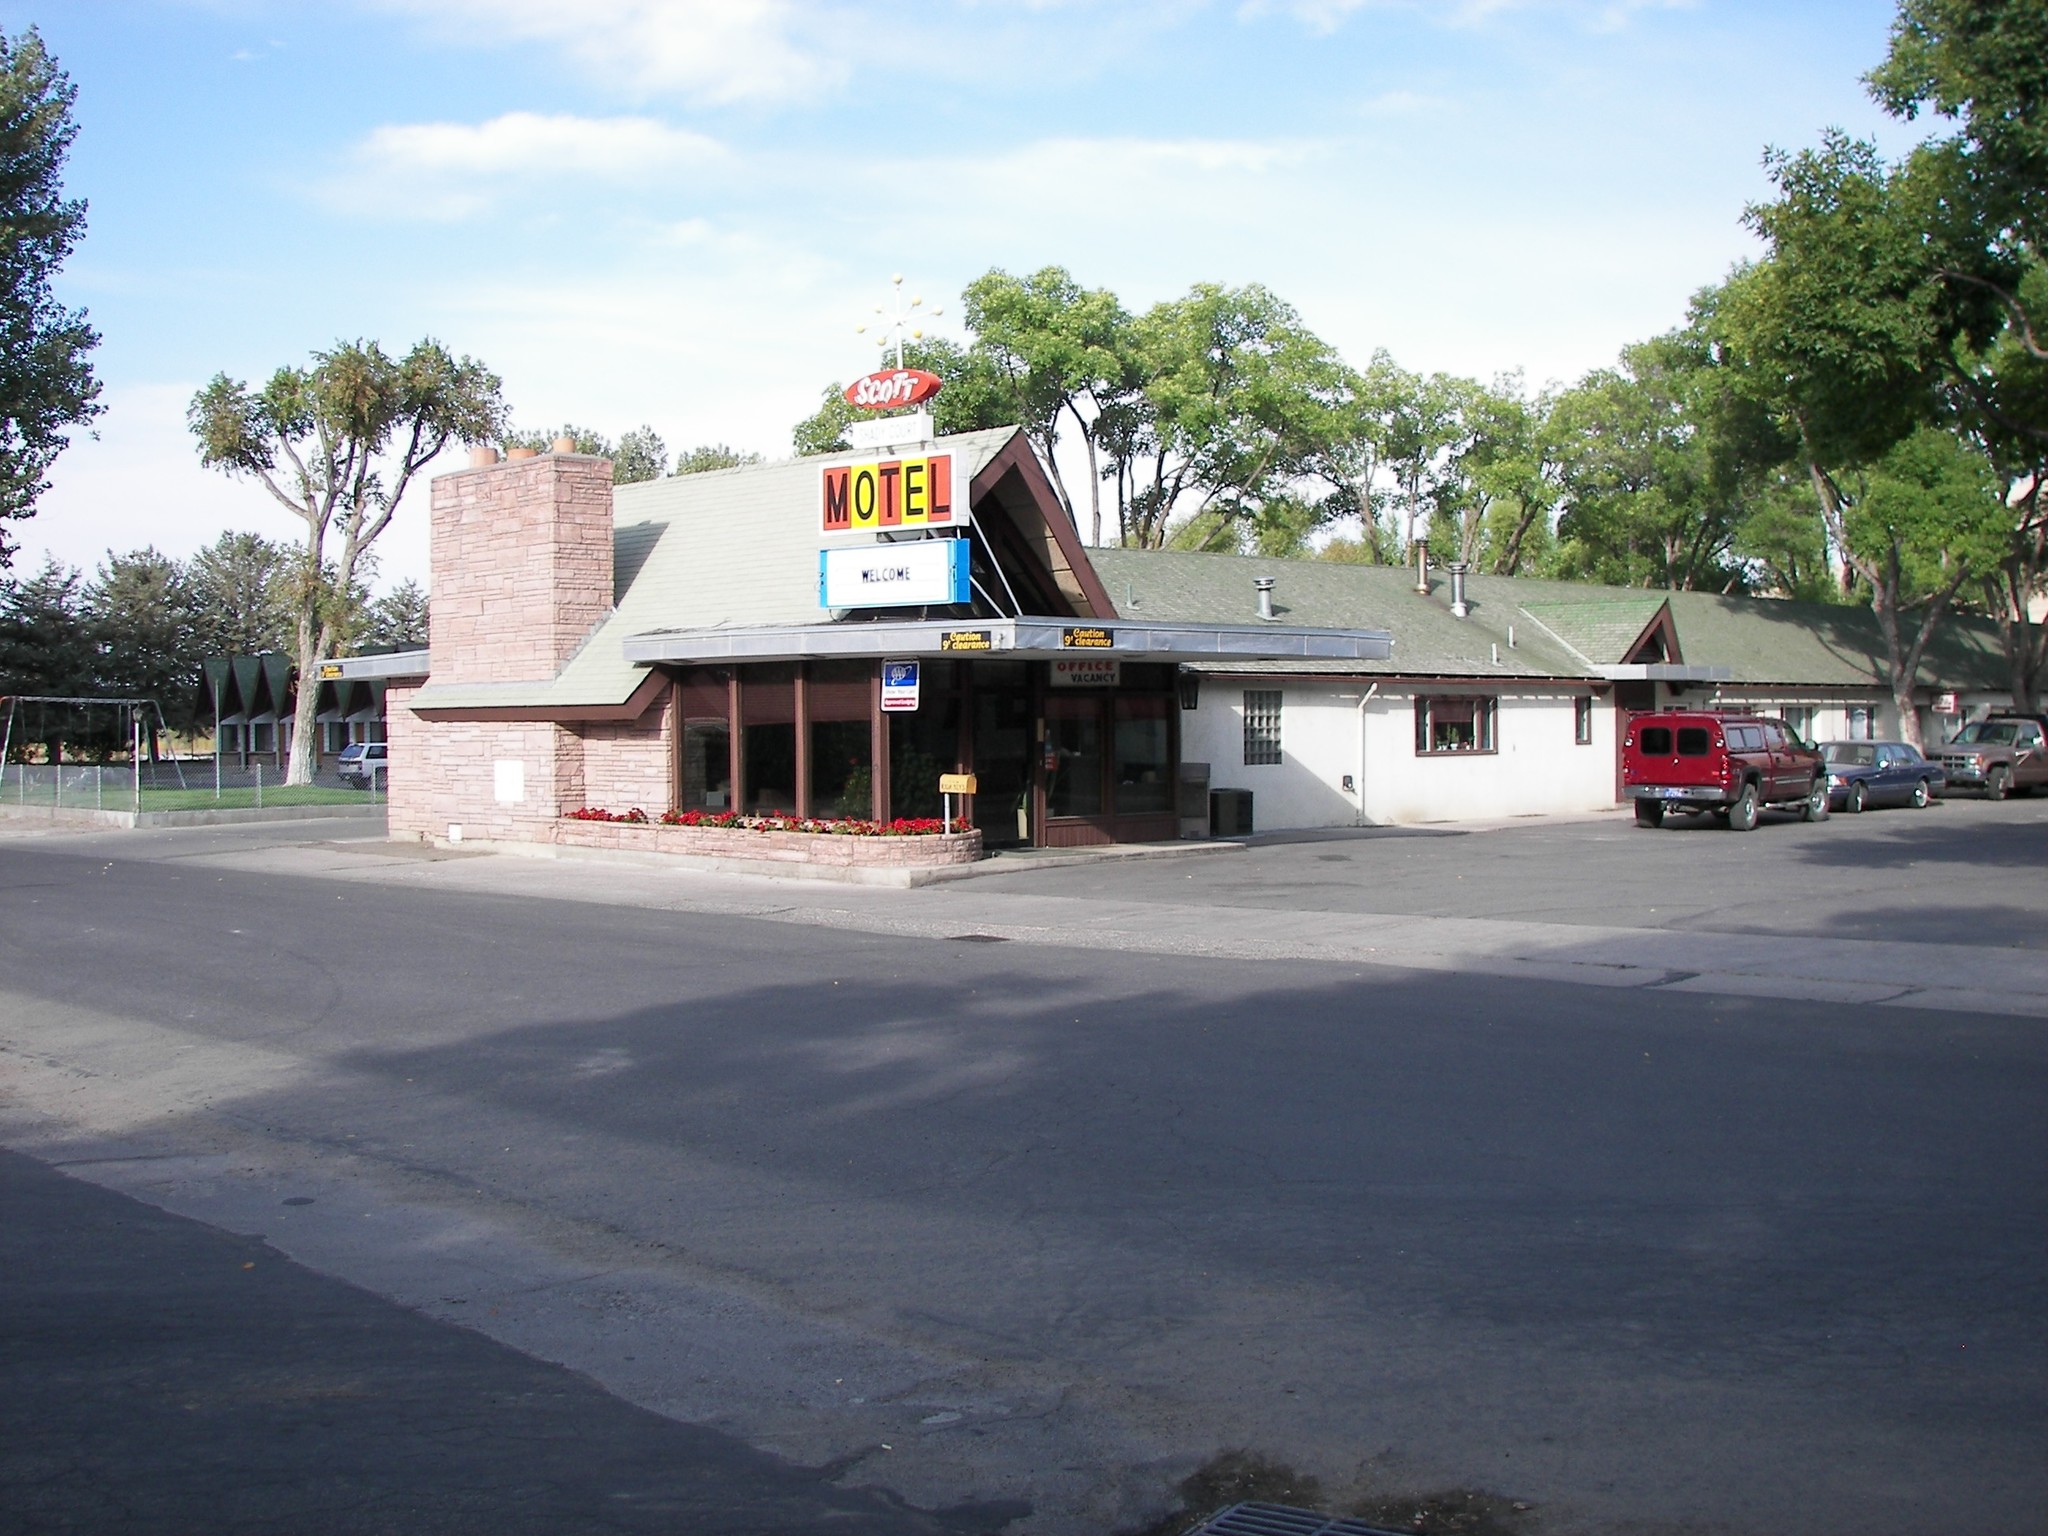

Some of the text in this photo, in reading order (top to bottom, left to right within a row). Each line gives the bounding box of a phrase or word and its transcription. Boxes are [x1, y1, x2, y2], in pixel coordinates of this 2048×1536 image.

[853, 371, 919, 406] SCOTT
[858, 421, 917, 443] SHADY COURT
[826, 462, 951, 523] MOTEL
[861, 566, 912, 583] WELCOME
[949, 631, 982, 641] Caution
[1072, 628, 1105, 638] Caution
[952, 640, 990, 650] clearance
[1074, 636, 1112, 647] clearance
[1056, 661, 1114, 672] OFFICE
[1071, 673, 1116, 683] VACANCY
